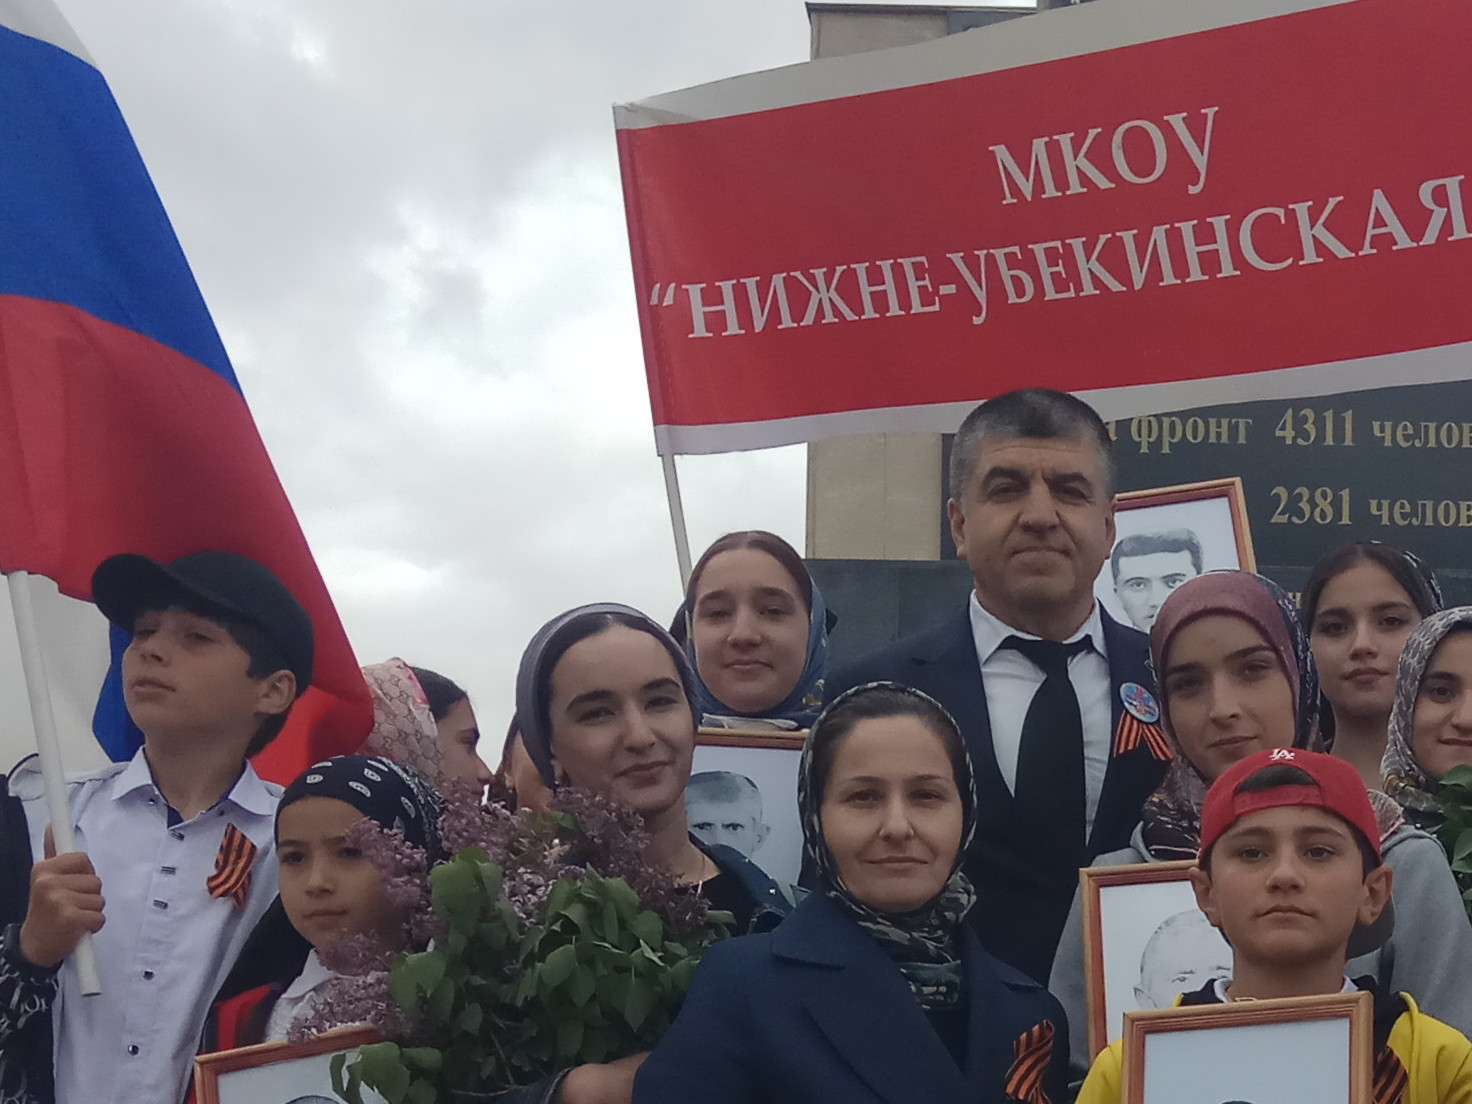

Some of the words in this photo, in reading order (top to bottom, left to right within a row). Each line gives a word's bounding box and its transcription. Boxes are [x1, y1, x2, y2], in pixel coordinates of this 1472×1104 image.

[989, 106, 1219, 205] МКОУ
[1130, 415, 1252, 454] фронт
[1274, 407, 1356, 446] 4311
[1269, 485, 1353, 525] 2381
